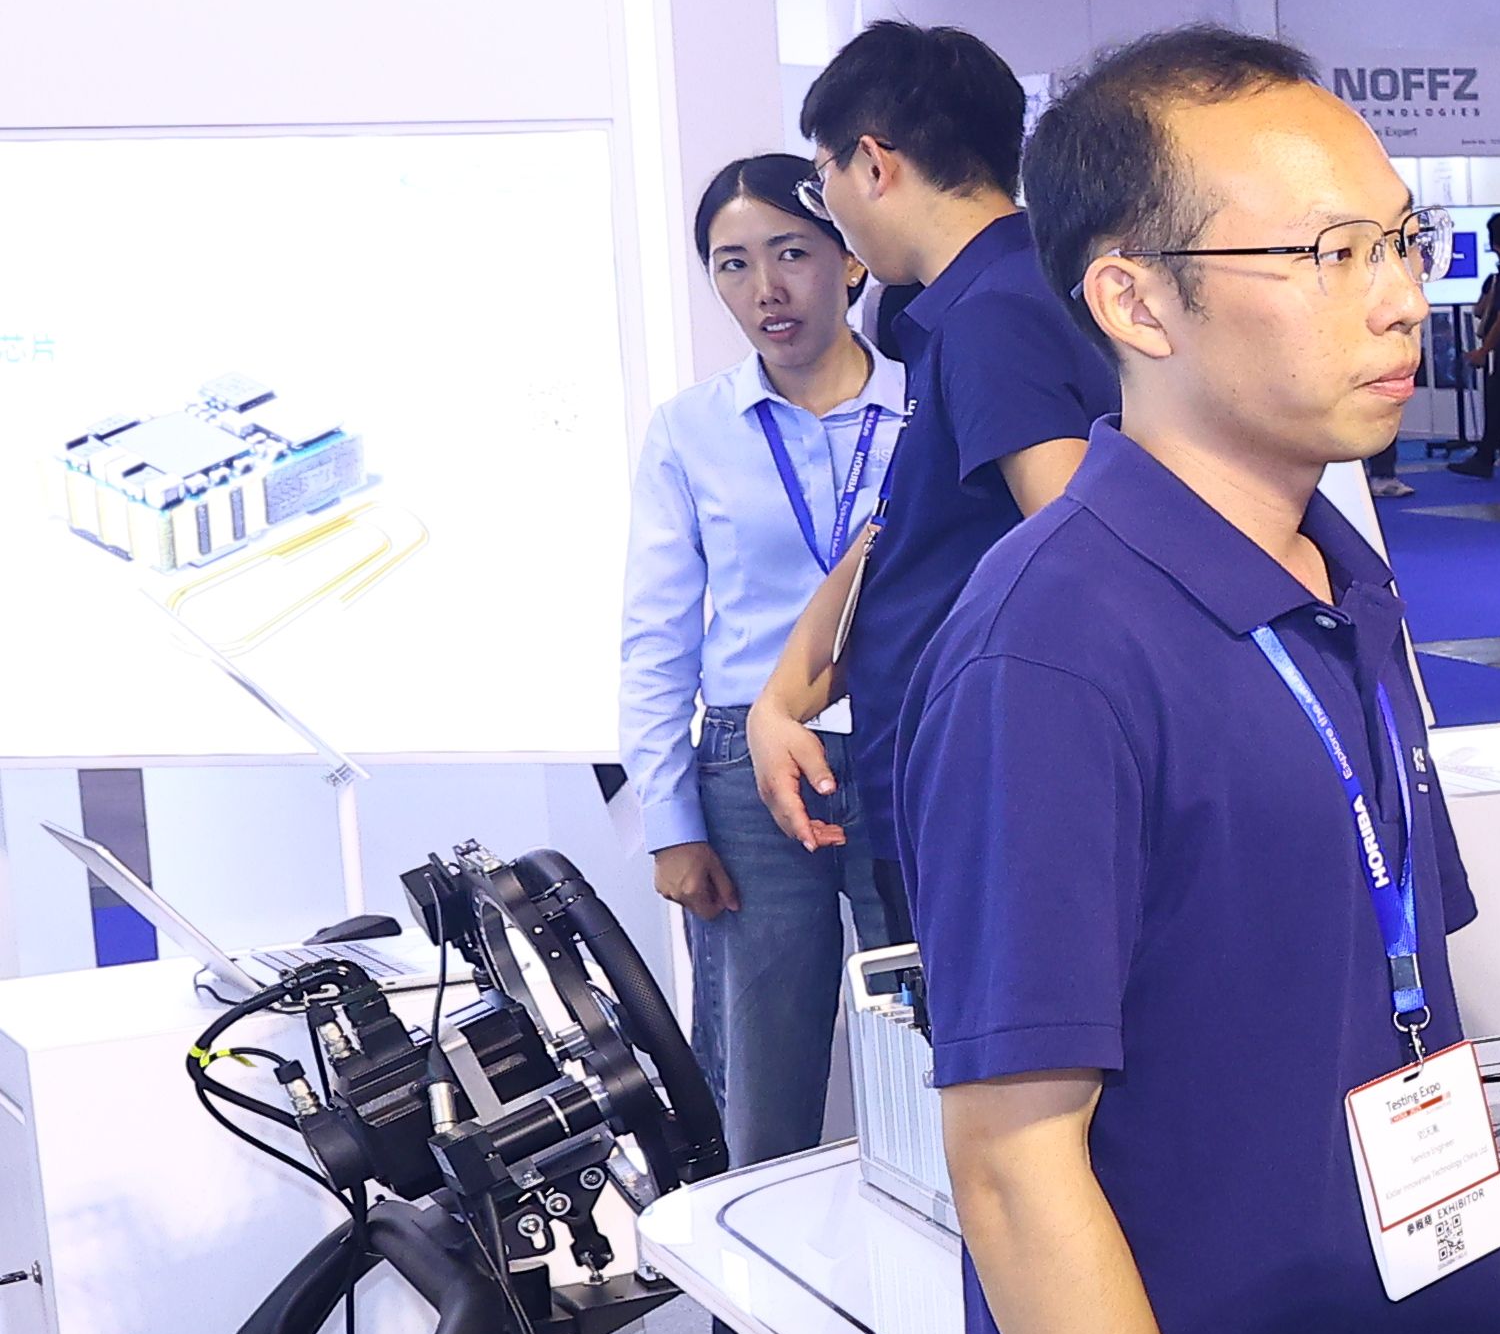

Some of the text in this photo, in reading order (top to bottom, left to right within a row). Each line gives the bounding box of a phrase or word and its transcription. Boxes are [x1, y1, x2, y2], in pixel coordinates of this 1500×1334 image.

[1333, 67, 1480, 102] NOFFZ
[1360, 107, 1481, 117] CHNOLOGIES
[1353, 794, 1391, 889] HORIBA
[1385, 1082, 1441, 1113] Testing Expo
[1437, 1187, 1486, 1220] EXHIBITOR
